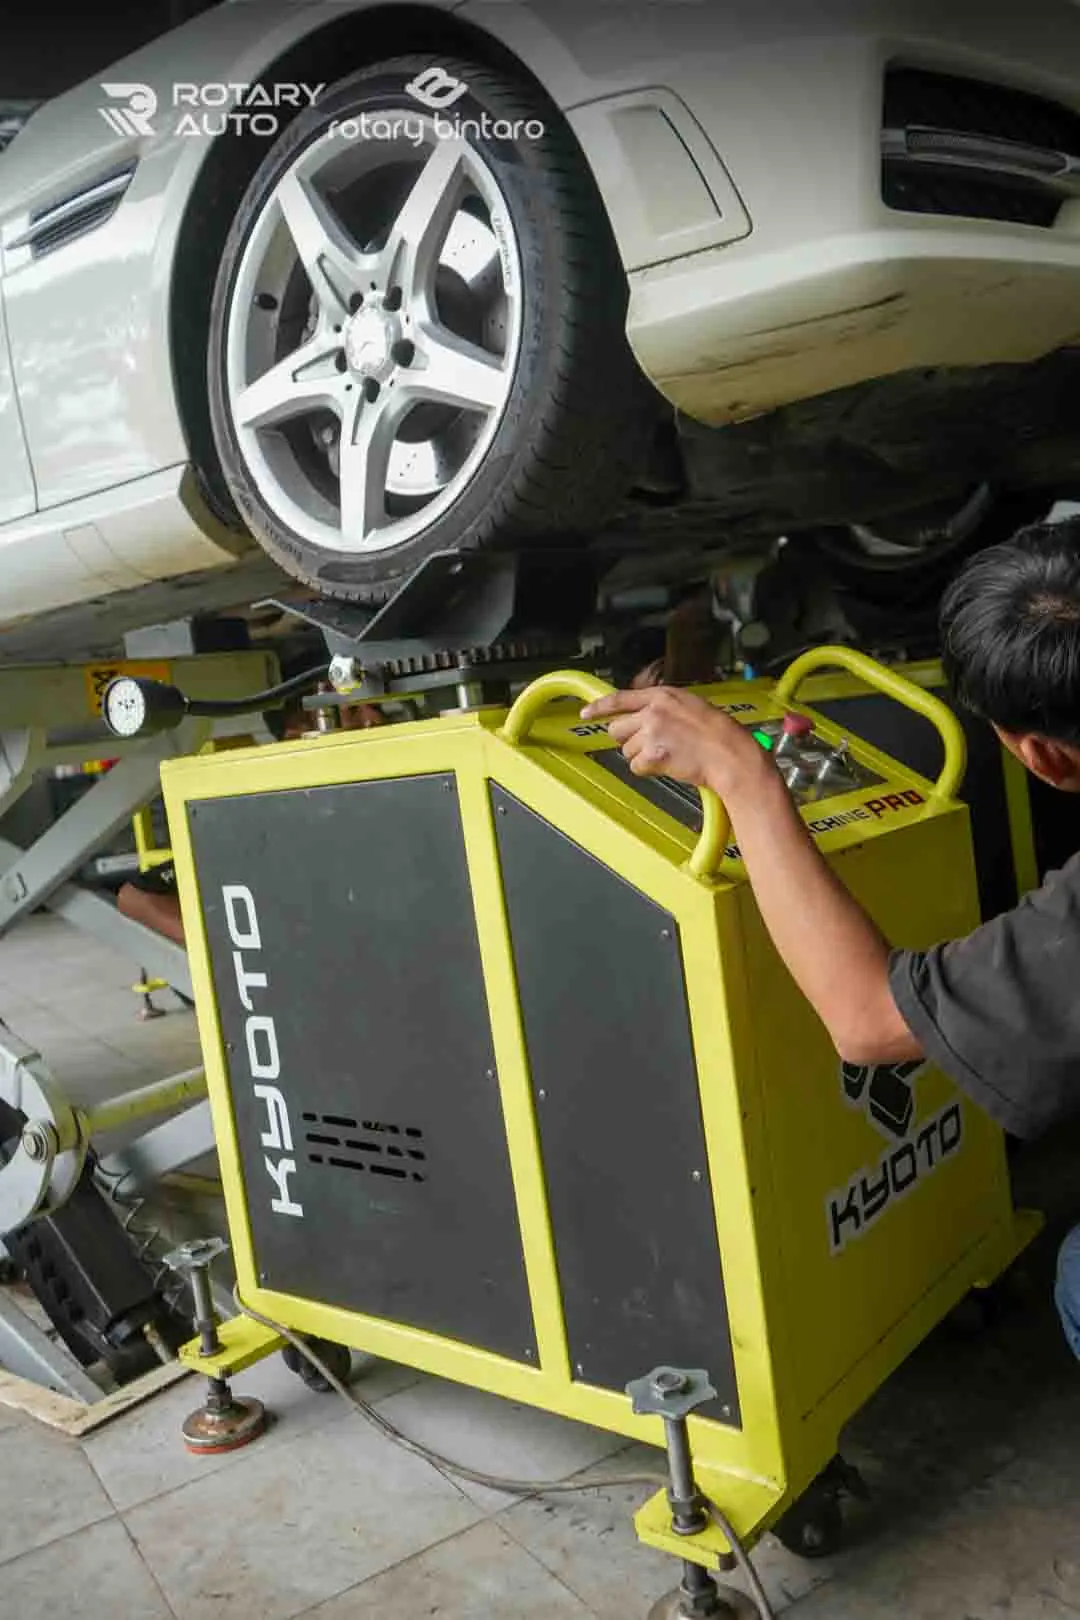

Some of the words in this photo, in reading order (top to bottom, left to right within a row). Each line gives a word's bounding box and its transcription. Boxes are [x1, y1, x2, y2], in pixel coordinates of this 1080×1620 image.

[807, 808, 870, 834] CHINE
[222, 885, 304, 1218] KYOTO
[830, 1102, 962, 1247] KYOTO
